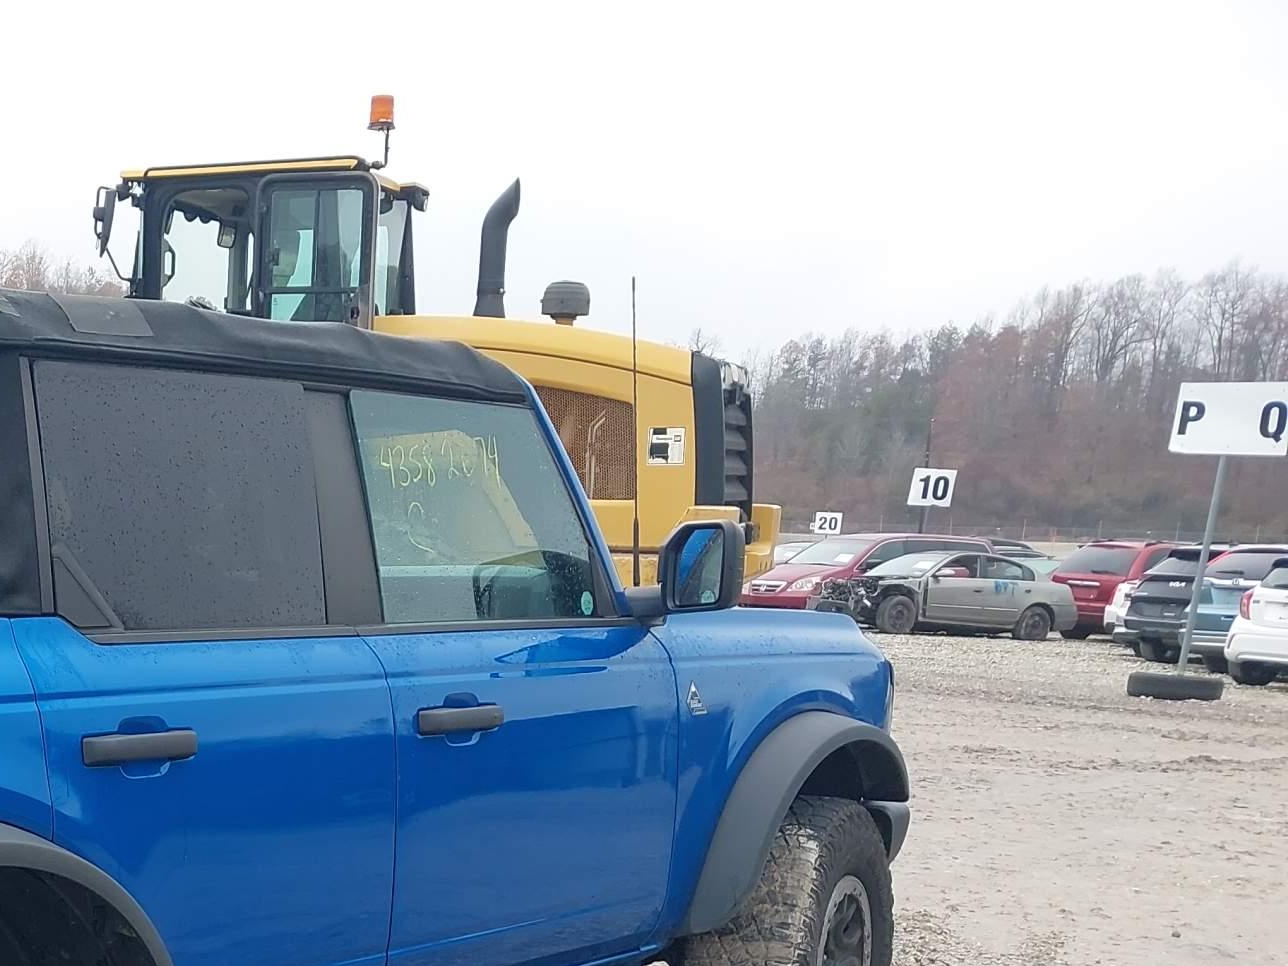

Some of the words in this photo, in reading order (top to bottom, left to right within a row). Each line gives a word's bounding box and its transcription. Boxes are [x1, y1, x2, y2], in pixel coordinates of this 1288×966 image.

[1177, 401, 1206, 435] P
[1259, 401, 1288, 443] Q
[919, 475, 950, 501] 10
[818, 516, 838, 530] 20
